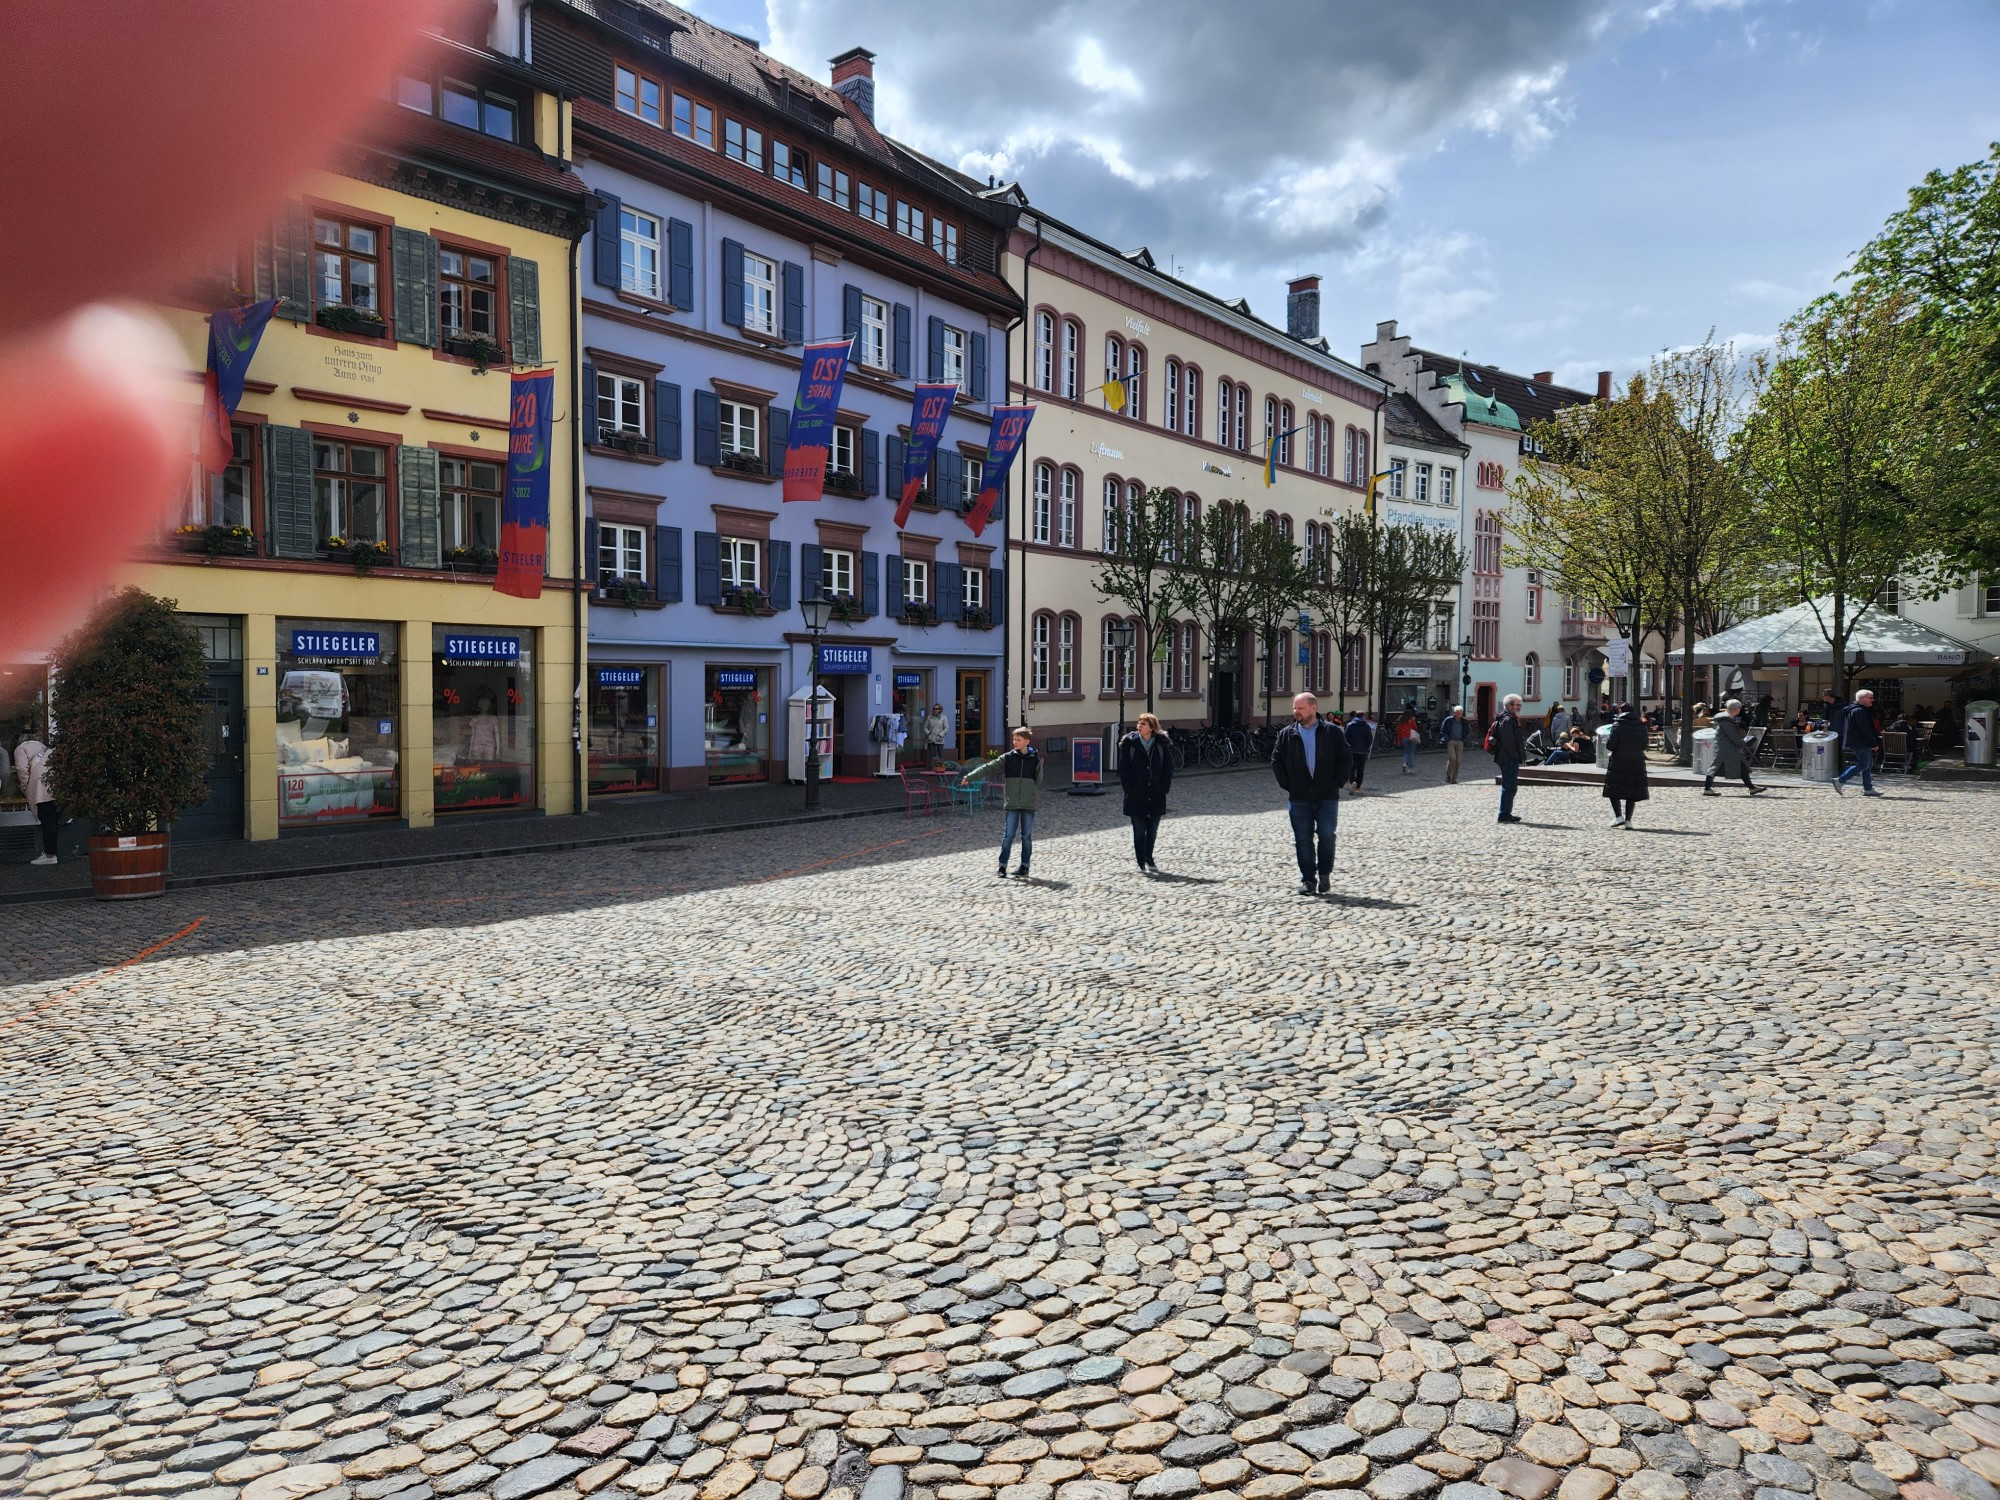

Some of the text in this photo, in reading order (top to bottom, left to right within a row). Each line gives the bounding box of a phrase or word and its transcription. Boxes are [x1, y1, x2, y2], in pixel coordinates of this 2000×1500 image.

[1125, 316, 1151, 338] Vielfalt
[356, 351, 373, 361] zum
[333, 367, 357, 380] Anno
[511, 434, 534, 454] AHRE
[1387, 508, 1457, 529] Pfandleihanstalt
[297, 635, 375, 652] STIEGELER
[449, 640, 517, 655] STIEGELER
[298, 657, 347, 665] SCHLAFKOMFORT
[824, 649, 868, 663] STIEGELER
[601, 672, 640, 682] STIEGELER
[721, 673, 754, 683] STIEGELER
[897, 675, 920, 683] STIEGELER
[287, 779, 309, 791] 120
